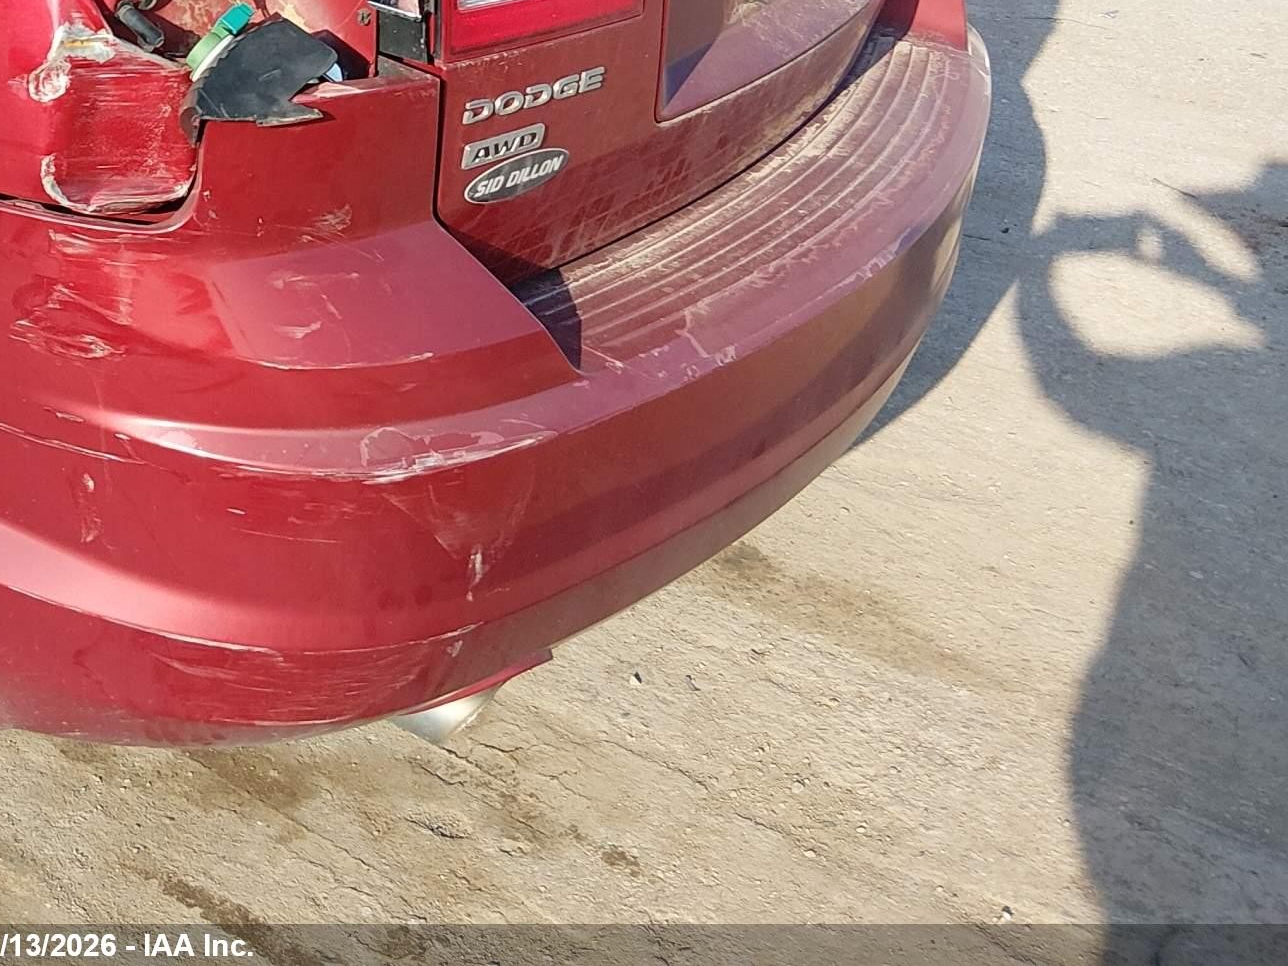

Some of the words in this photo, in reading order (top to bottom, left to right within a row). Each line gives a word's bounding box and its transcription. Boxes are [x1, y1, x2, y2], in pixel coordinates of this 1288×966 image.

[462, 66, 606, 126] DODGE
[471, 132, 538, 163] AWD
[474, 175, 503, 198] SID
[505, 155, 565, 189] DILLON
